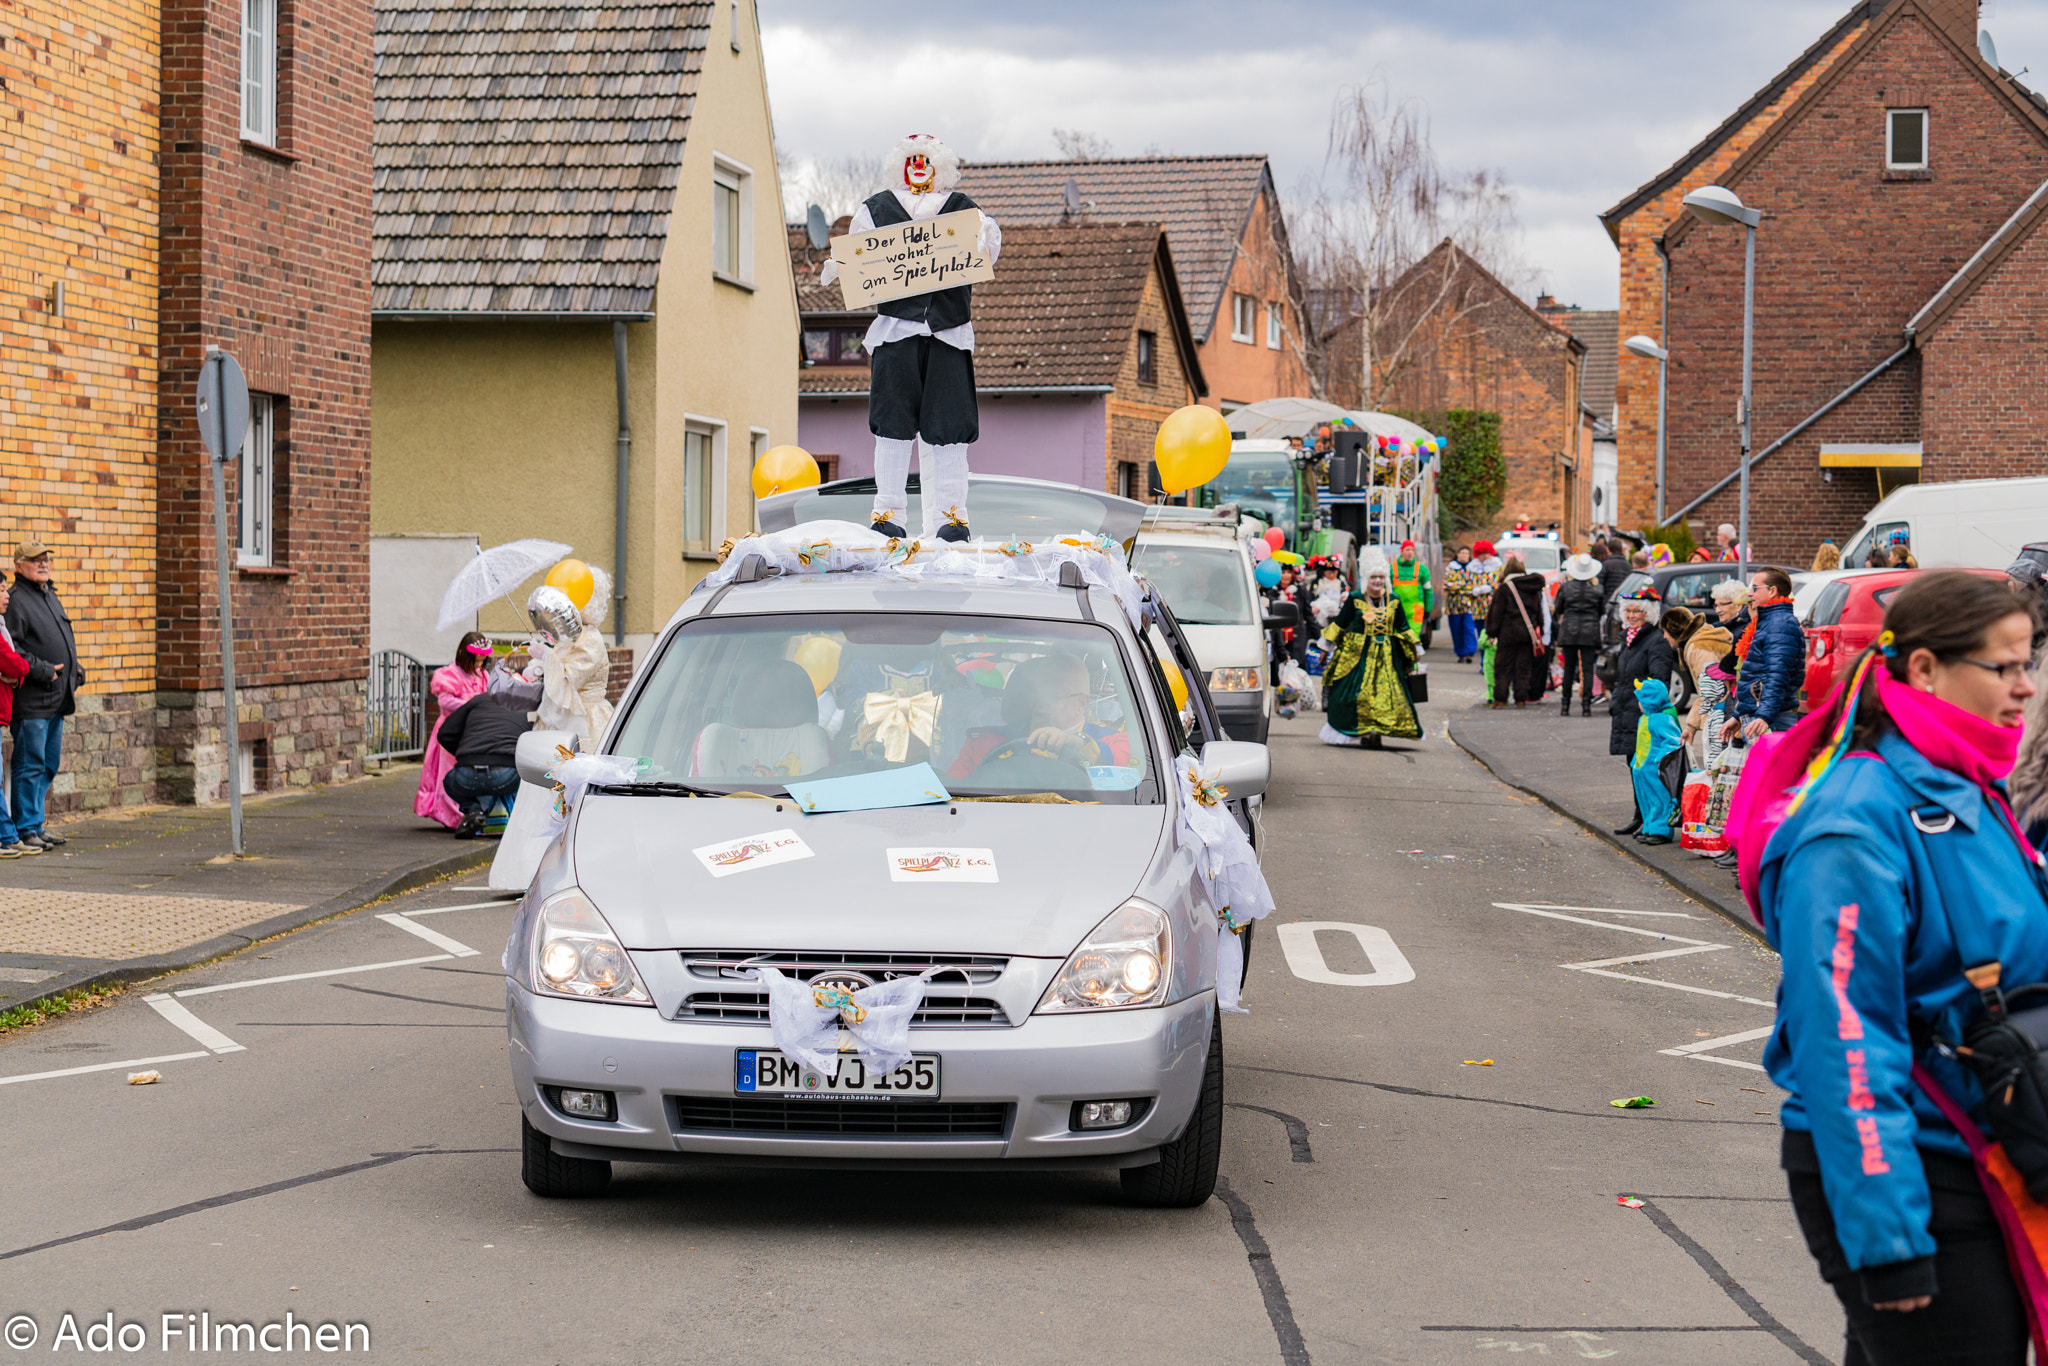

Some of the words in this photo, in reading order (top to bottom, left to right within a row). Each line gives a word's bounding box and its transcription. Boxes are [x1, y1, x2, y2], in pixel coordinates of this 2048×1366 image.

[865, 236, 896, 251] Der
[903, 222, 941, 244] Adel
[885, 243, 934, 263] wohnt
[862, 276, 888, 290] am
[893, 251, 984, 287] Spielplatz
[773, 839, 799, 848] K.G.
[967, 858, 991, 866] K.G.
[743, 1075, 751, 1084] D
[758, 1056, 800, 1088] BM
[827, 1058, 865, 1089] VJ
[873, 1060, 934, 1090] 155
[784, 1093, 891, 1101] www.autohaus-schaeben.de
